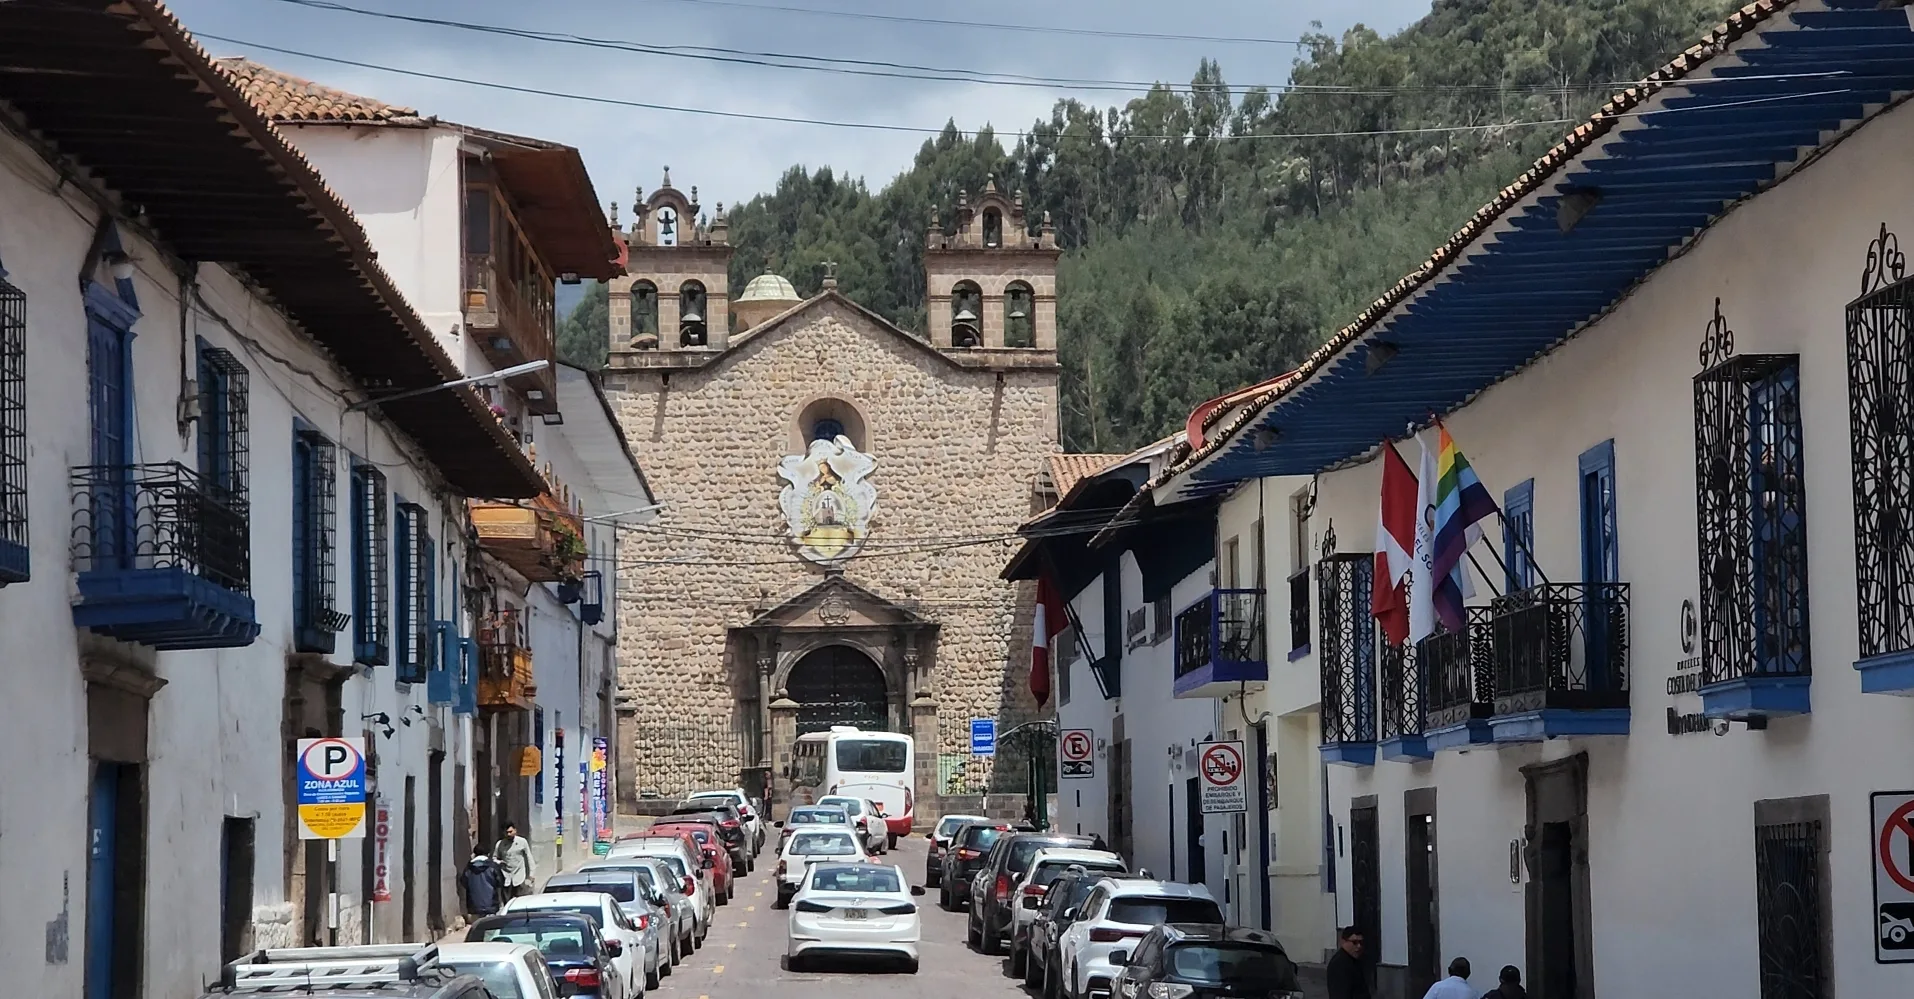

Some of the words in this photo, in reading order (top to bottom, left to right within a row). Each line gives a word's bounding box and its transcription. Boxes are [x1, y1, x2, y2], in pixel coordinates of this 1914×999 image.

[325, 746, 347, 775] P
[304, 781, 331, 789] ZONA
[334, 780, 359, 788] AZUL
[376, 809, 389, 891] BOTICA
